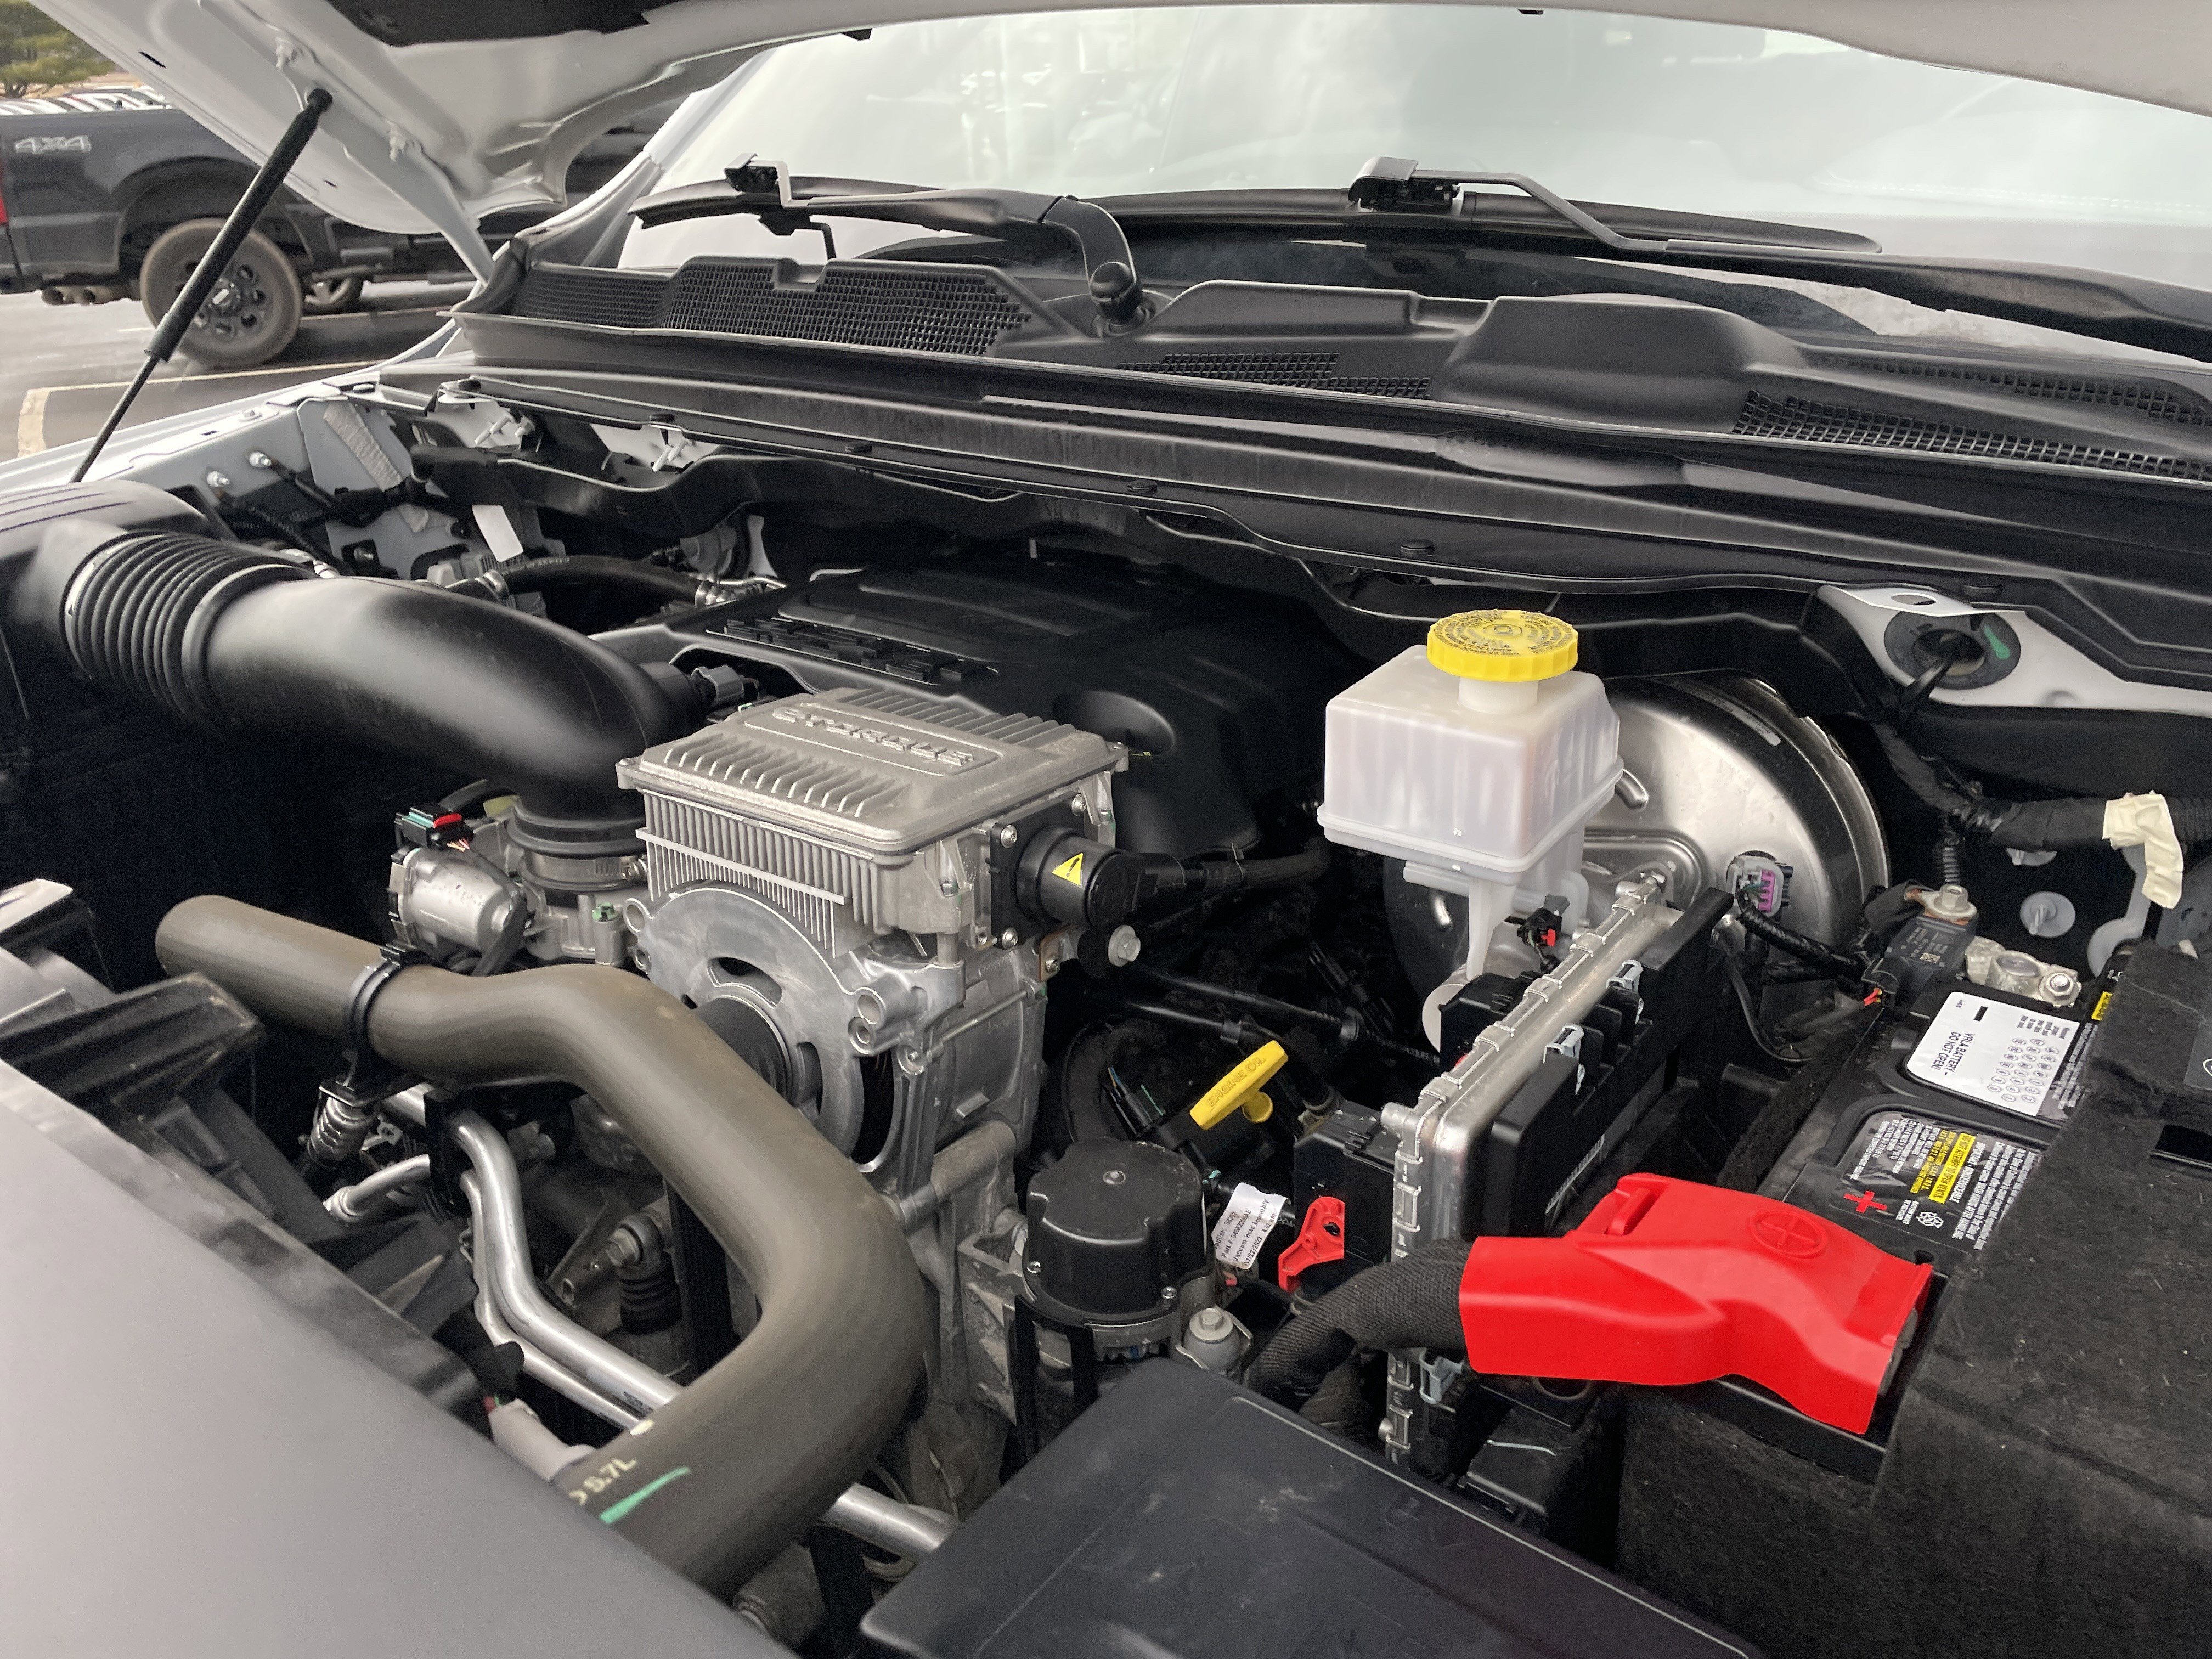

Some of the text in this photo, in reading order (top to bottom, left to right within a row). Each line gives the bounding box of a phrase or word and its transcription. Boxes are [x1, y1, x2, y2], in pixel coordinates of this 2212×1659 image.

[1931, 1032, 1961, 1070] DO NOT OPEN!
[1959, 1033, 1975, 1047] VRLA
[1945, 1047, 1966, 1072] BATTERY
[1207, 1057, 1266, 1107] ENGINE OIL
[1232, 1199, 1269, 1261] Vacuum Hose Assembly
[1221, 1245, 1232, 1257] Part
[1244, 1236, 1263, 1266] 07/22/2022
